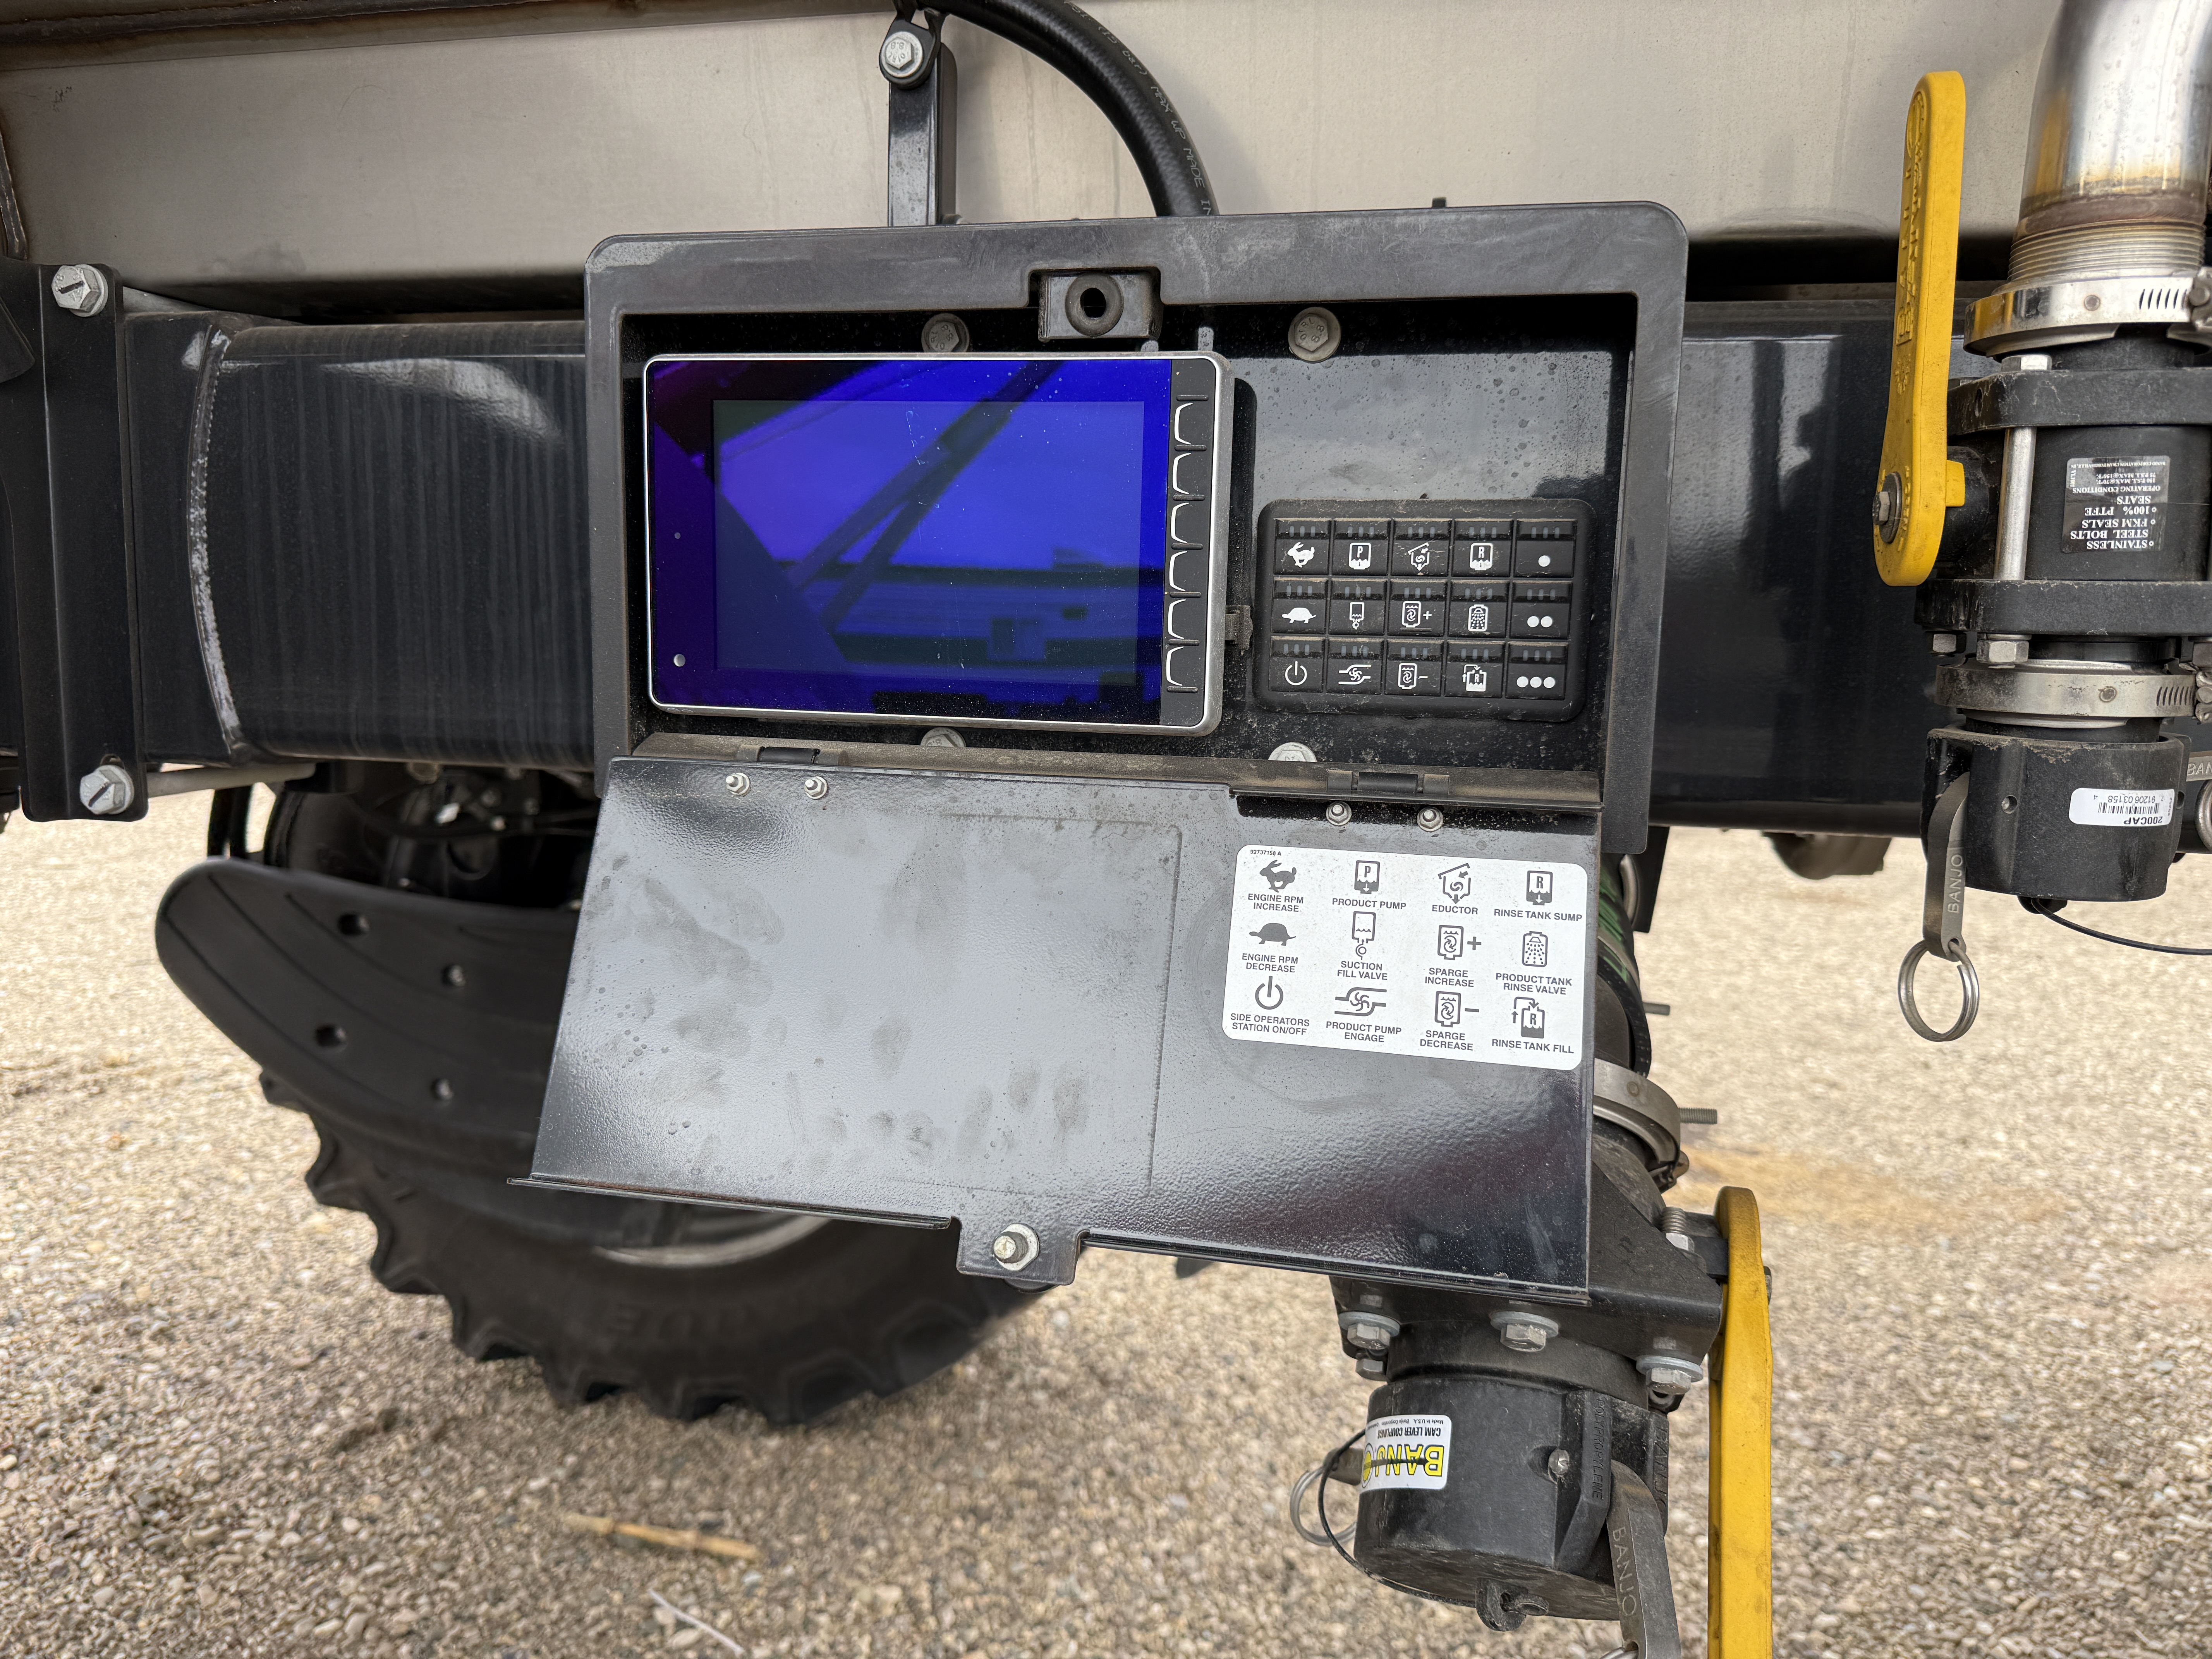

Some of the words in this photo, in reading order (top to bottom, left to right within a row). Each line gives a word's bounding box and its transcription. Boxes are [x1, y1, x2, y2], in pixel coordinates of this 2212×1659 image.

[1151, 86, 1173, 113] MAX
[1171, 120, 1186, 139] WP
[1183, 148, 1205, 188] MADE
[2116, 495, 2151, 504] SEATS
[2084, 507, 2115, 516] PTFE
[2123, 506, 2150, 515] 100%
[2081, 519, 2119, 529] SEALS
[2121, 518, 2148, 527] FKM
[2070, 530, 2108, 539] BOLTS
[2113, 529, 2149, 538] STEEL
[2086, 539, 2148, 550] STAINLESS
[2107, 795, 2133, 803] 03158
[2135, 795, 2155, 804] 91206
[2123, 816, 2163, 825] 200CAP
[1947, 854, 1963, 913] BANJO
[1248, 893, 1281, 903] ENGINE
[1284, 895, 1304, 904] RPM
[1332, 898, 1377, 908] PRODUCT
[1379, 901, 1407, 910] PUMP
[1254, 902, 1299, 912] INCREASE
[1432, 904, 1478, 915] EDUCTOR
[1494, 908, 1523, 918] RINSE
[1525, 910, 1551, 920] TANK
[1554, 912, 1582, 922] SUMP
[1242, 953, 1276, 964] ENGINE
[1278, 956, 1298, 964] RPM
[1246, 962, 1295, 973] DECREASE
[1341, 960, 1382, 971] SUCTION
[1337, 969, 1357, 978] FILL
[1358, 971, 1388, 981] VALVE
[1429, 967, 1468, 978] SPARGE
[1425, 976, 1474, 988] INCREASE
[1496, 972, 1544, 984] PRODUCT
[1545, 977, 1572, 986] TANK
[1503, 983, 1533, 992] RINSE
[1535, 985, 1566, 995] VALVE
[1230, 1013, 1251, 1022] SIDE
[1254, 1015, 1310, 1027] OPERATORS
[1232, 1022, 1270, 1032] STATION
[1273, 1025, 1307, 1036] ON/OFF
[1326, 1021, 1372, 1032] PRODUCT
[1374, 1025, 1402, 1034] PUMP
[1344, 1032, 1384, 1042] ENGAGE
[1425, 1030, 1465, 1041] SPARGE
[1420, 1039, 1473, 1051] DECREASE
[1492, 1039, 1522, 1049] RINSE
[1524, 1041, 1550, 1052] TANK
[1553, 1044, 1574, 1054] FILL
[1377, 1427, 1403, 1439] COUPLINGS
[1404, 1427, 1423, 1436] LEVER
[1424, 1427, 1441, 1437] CAM
[1592, 1398, 1606, 1500] POLYPROPYLENE
[1362, 1443, 1445, 1488] BANJO
[1613, 1526, 1637, 1616] BANJO
